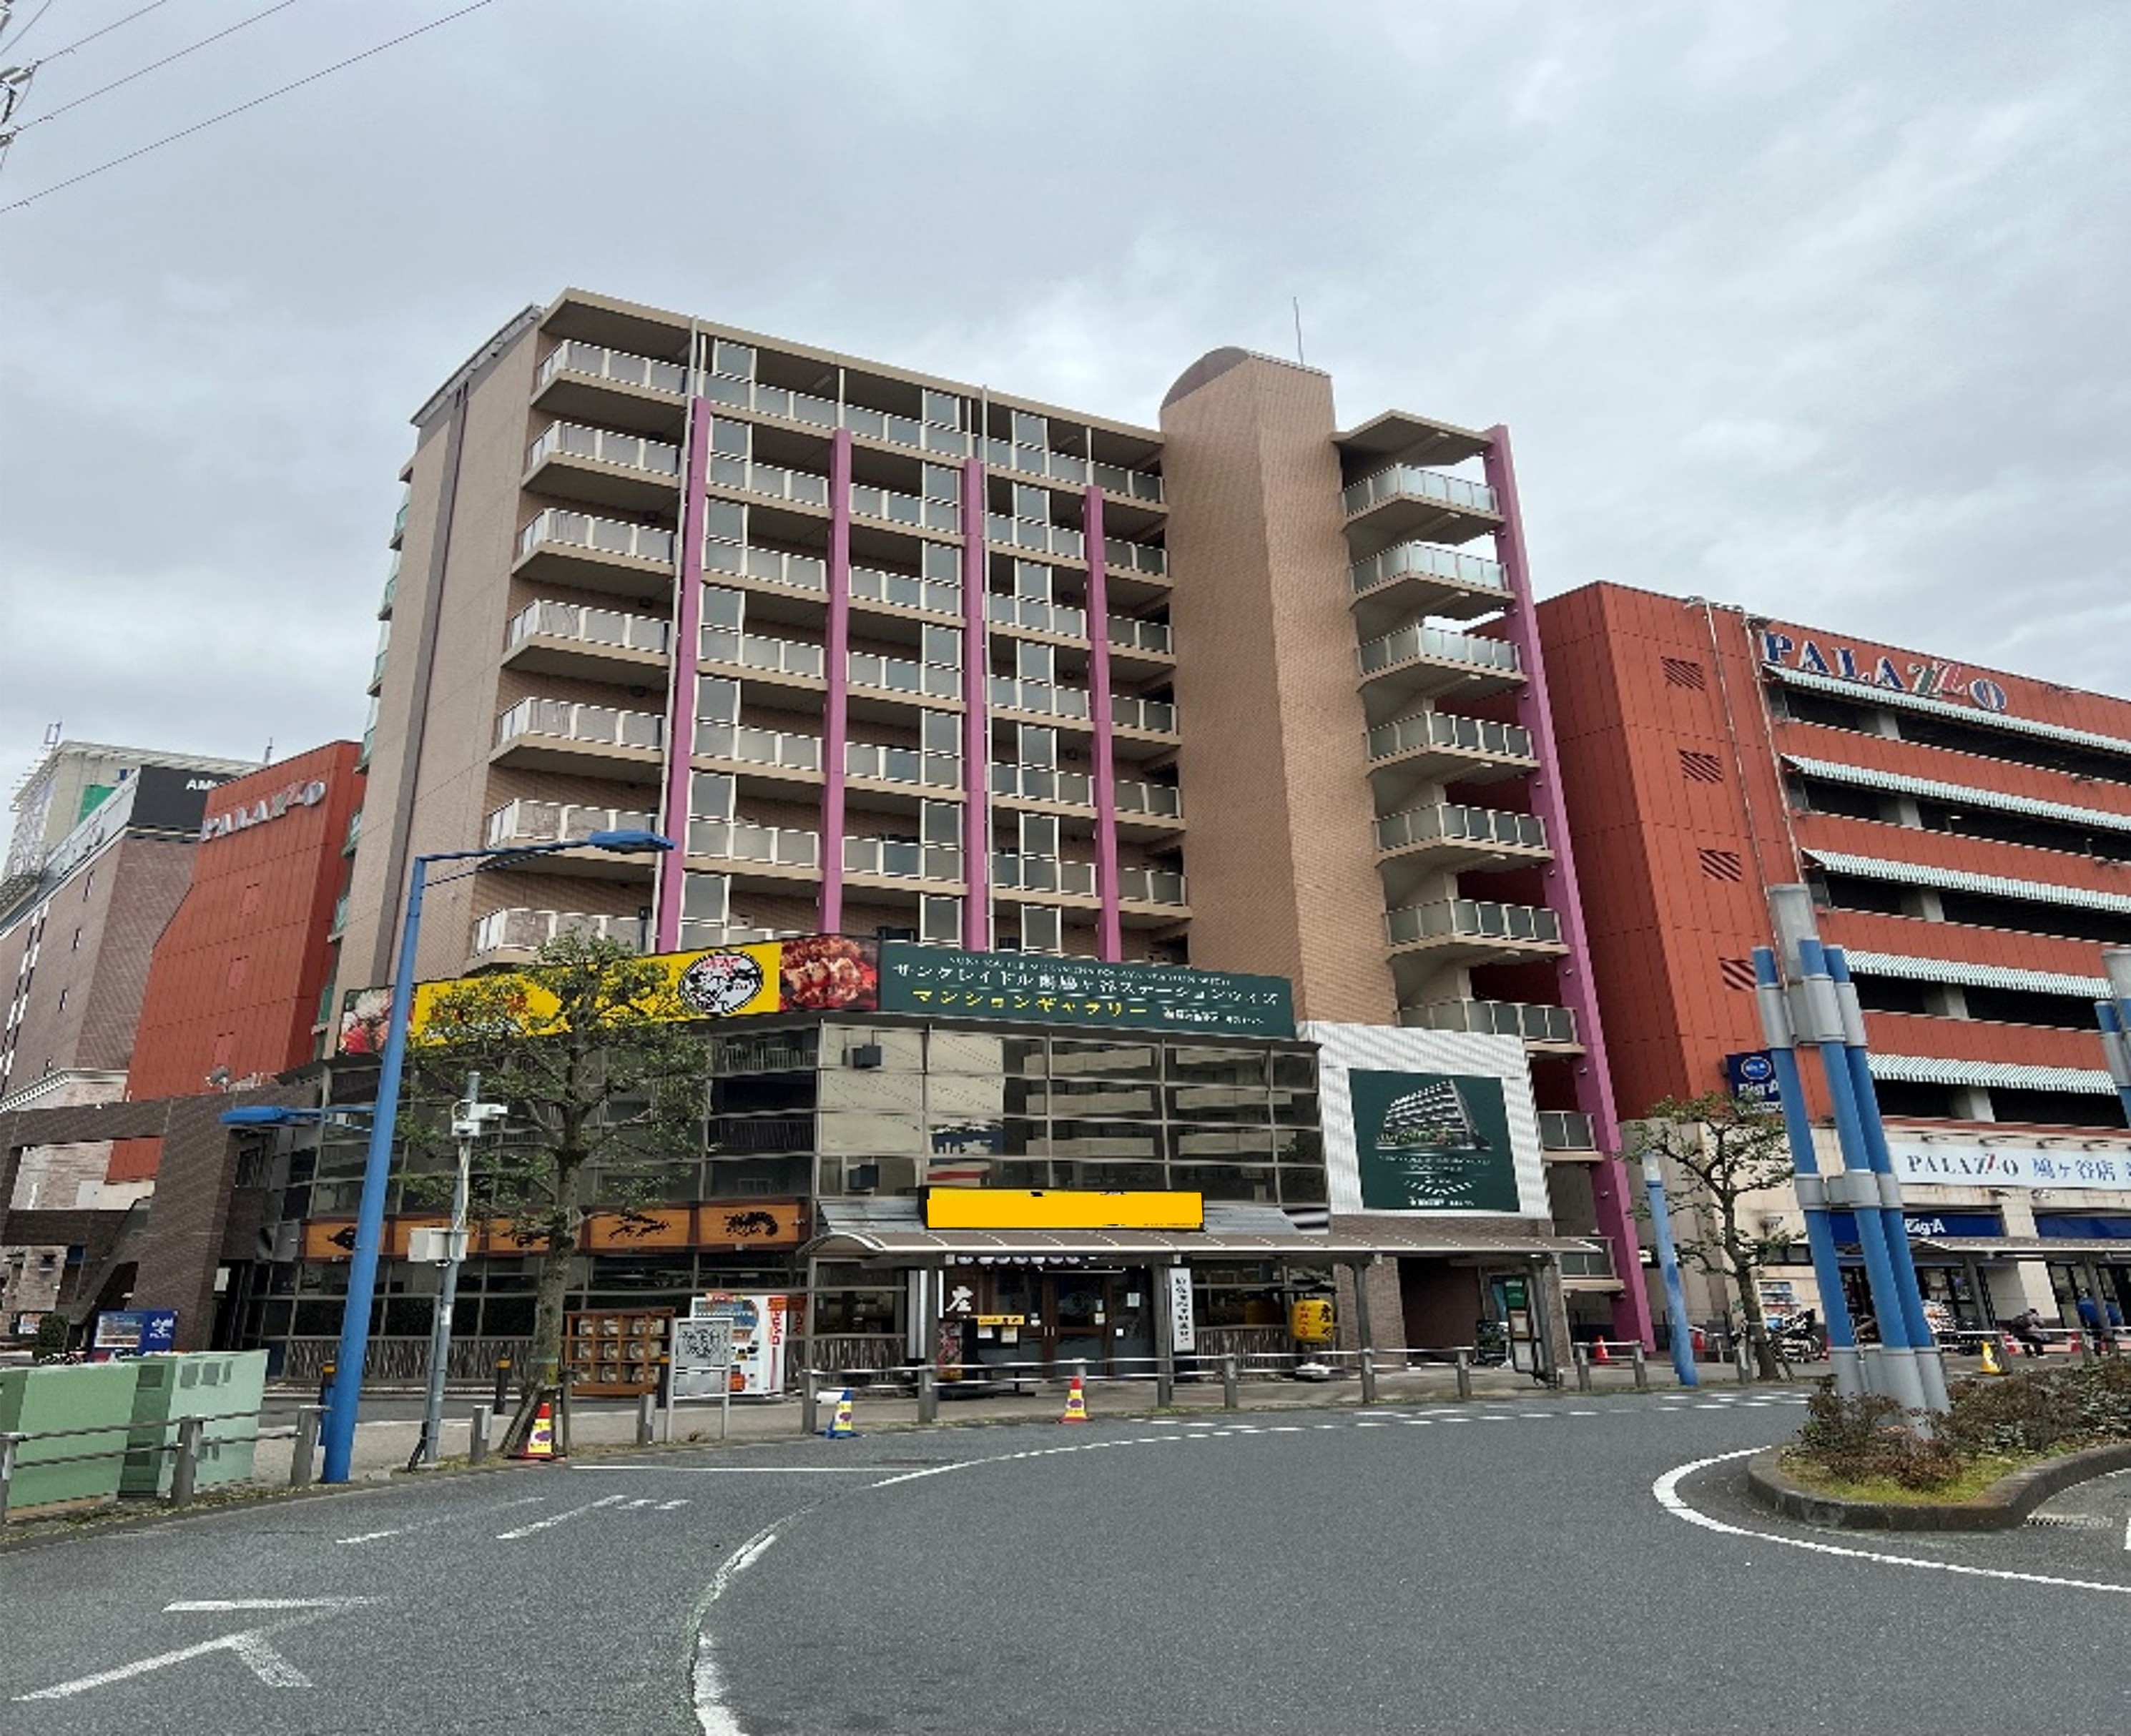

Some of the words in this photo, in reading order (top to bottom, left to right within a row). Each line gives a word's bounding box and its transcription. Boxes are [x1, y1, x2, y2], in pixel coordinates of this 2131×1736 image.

[1757, 629, 2007, 711] PALAZZO
[201, 781, 325, 842] PALAZZO
[912, 990, 1148, 1017] マンションギャラリー
[1907, 1153, 2019, 1177] PALAZZO
